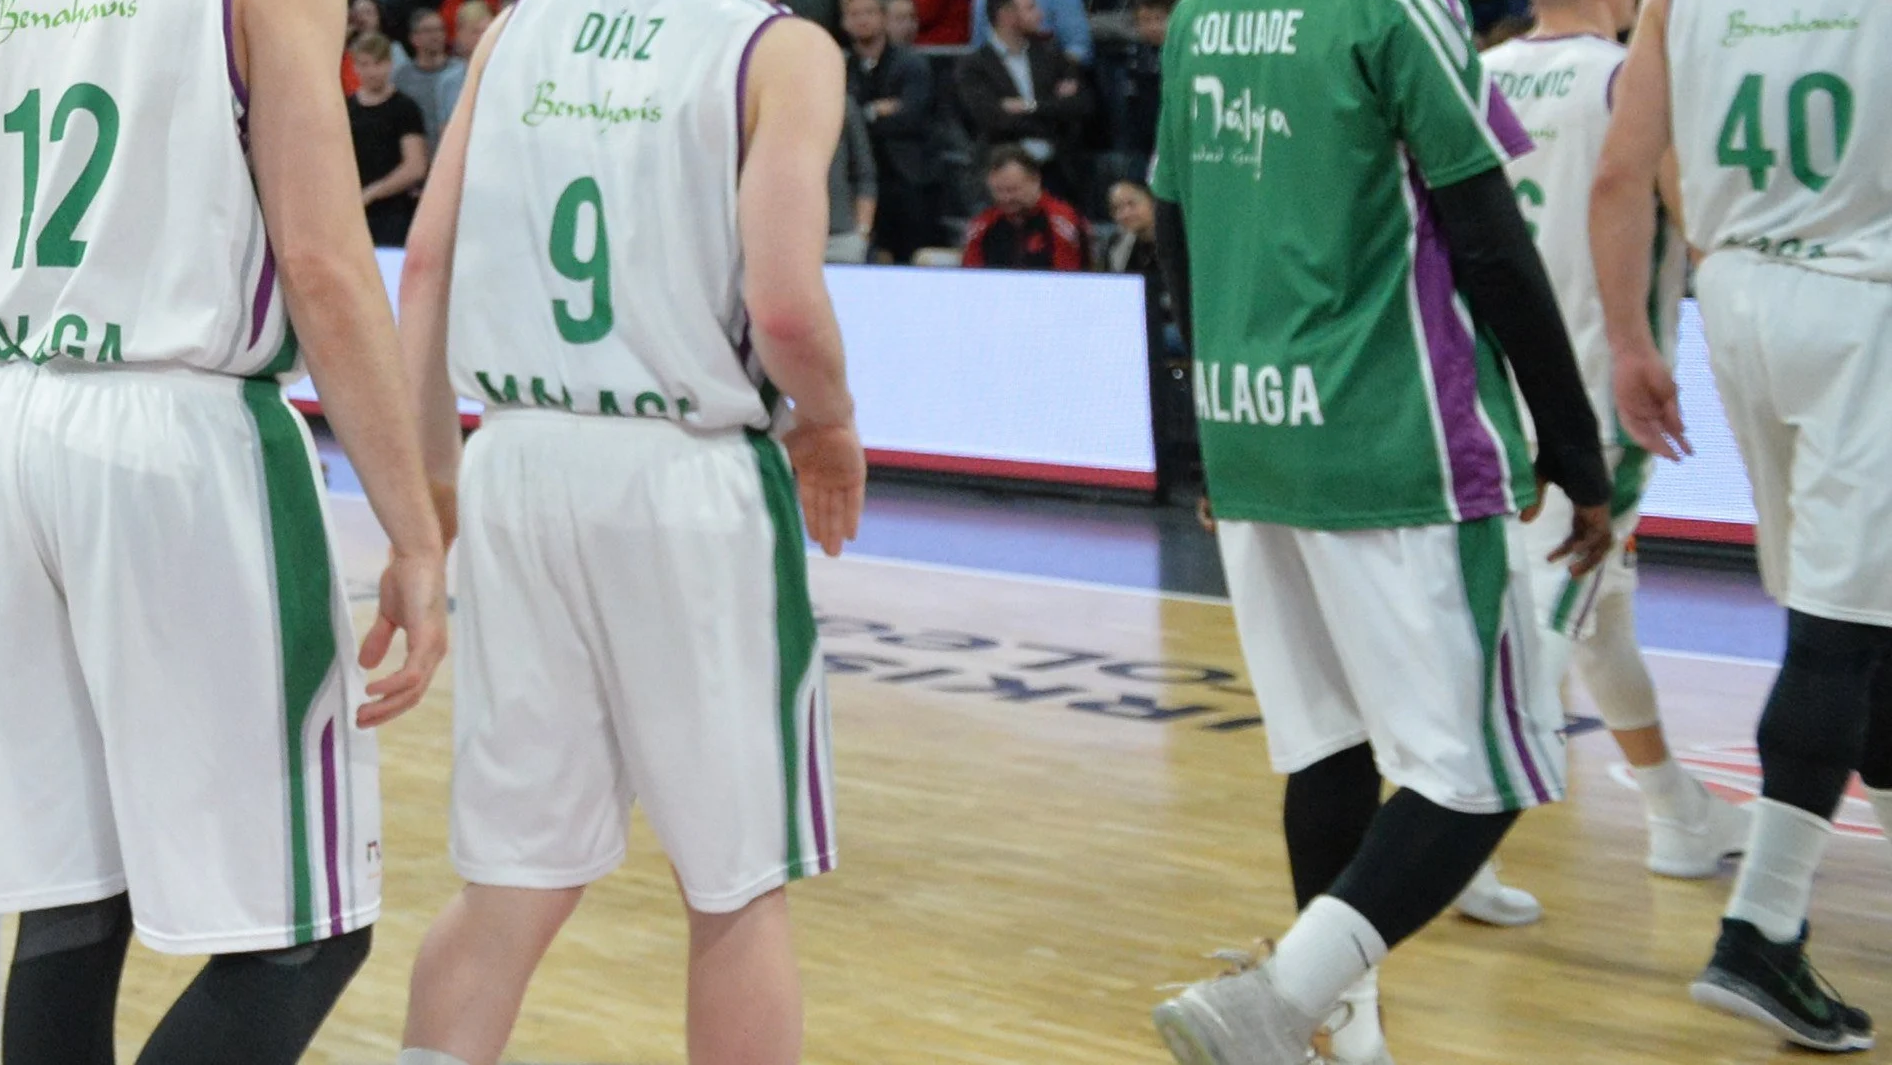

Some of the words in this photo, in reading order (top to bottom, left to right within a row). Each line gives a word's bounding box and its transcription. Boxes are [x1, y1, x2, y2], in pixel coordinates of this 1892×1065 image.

[573, 9, 665, 61] DÍAZ
[4, 82, 120, 269] 12
[1717, 72, 1854, 193] 40
[549, 176, 614, 345] 9
